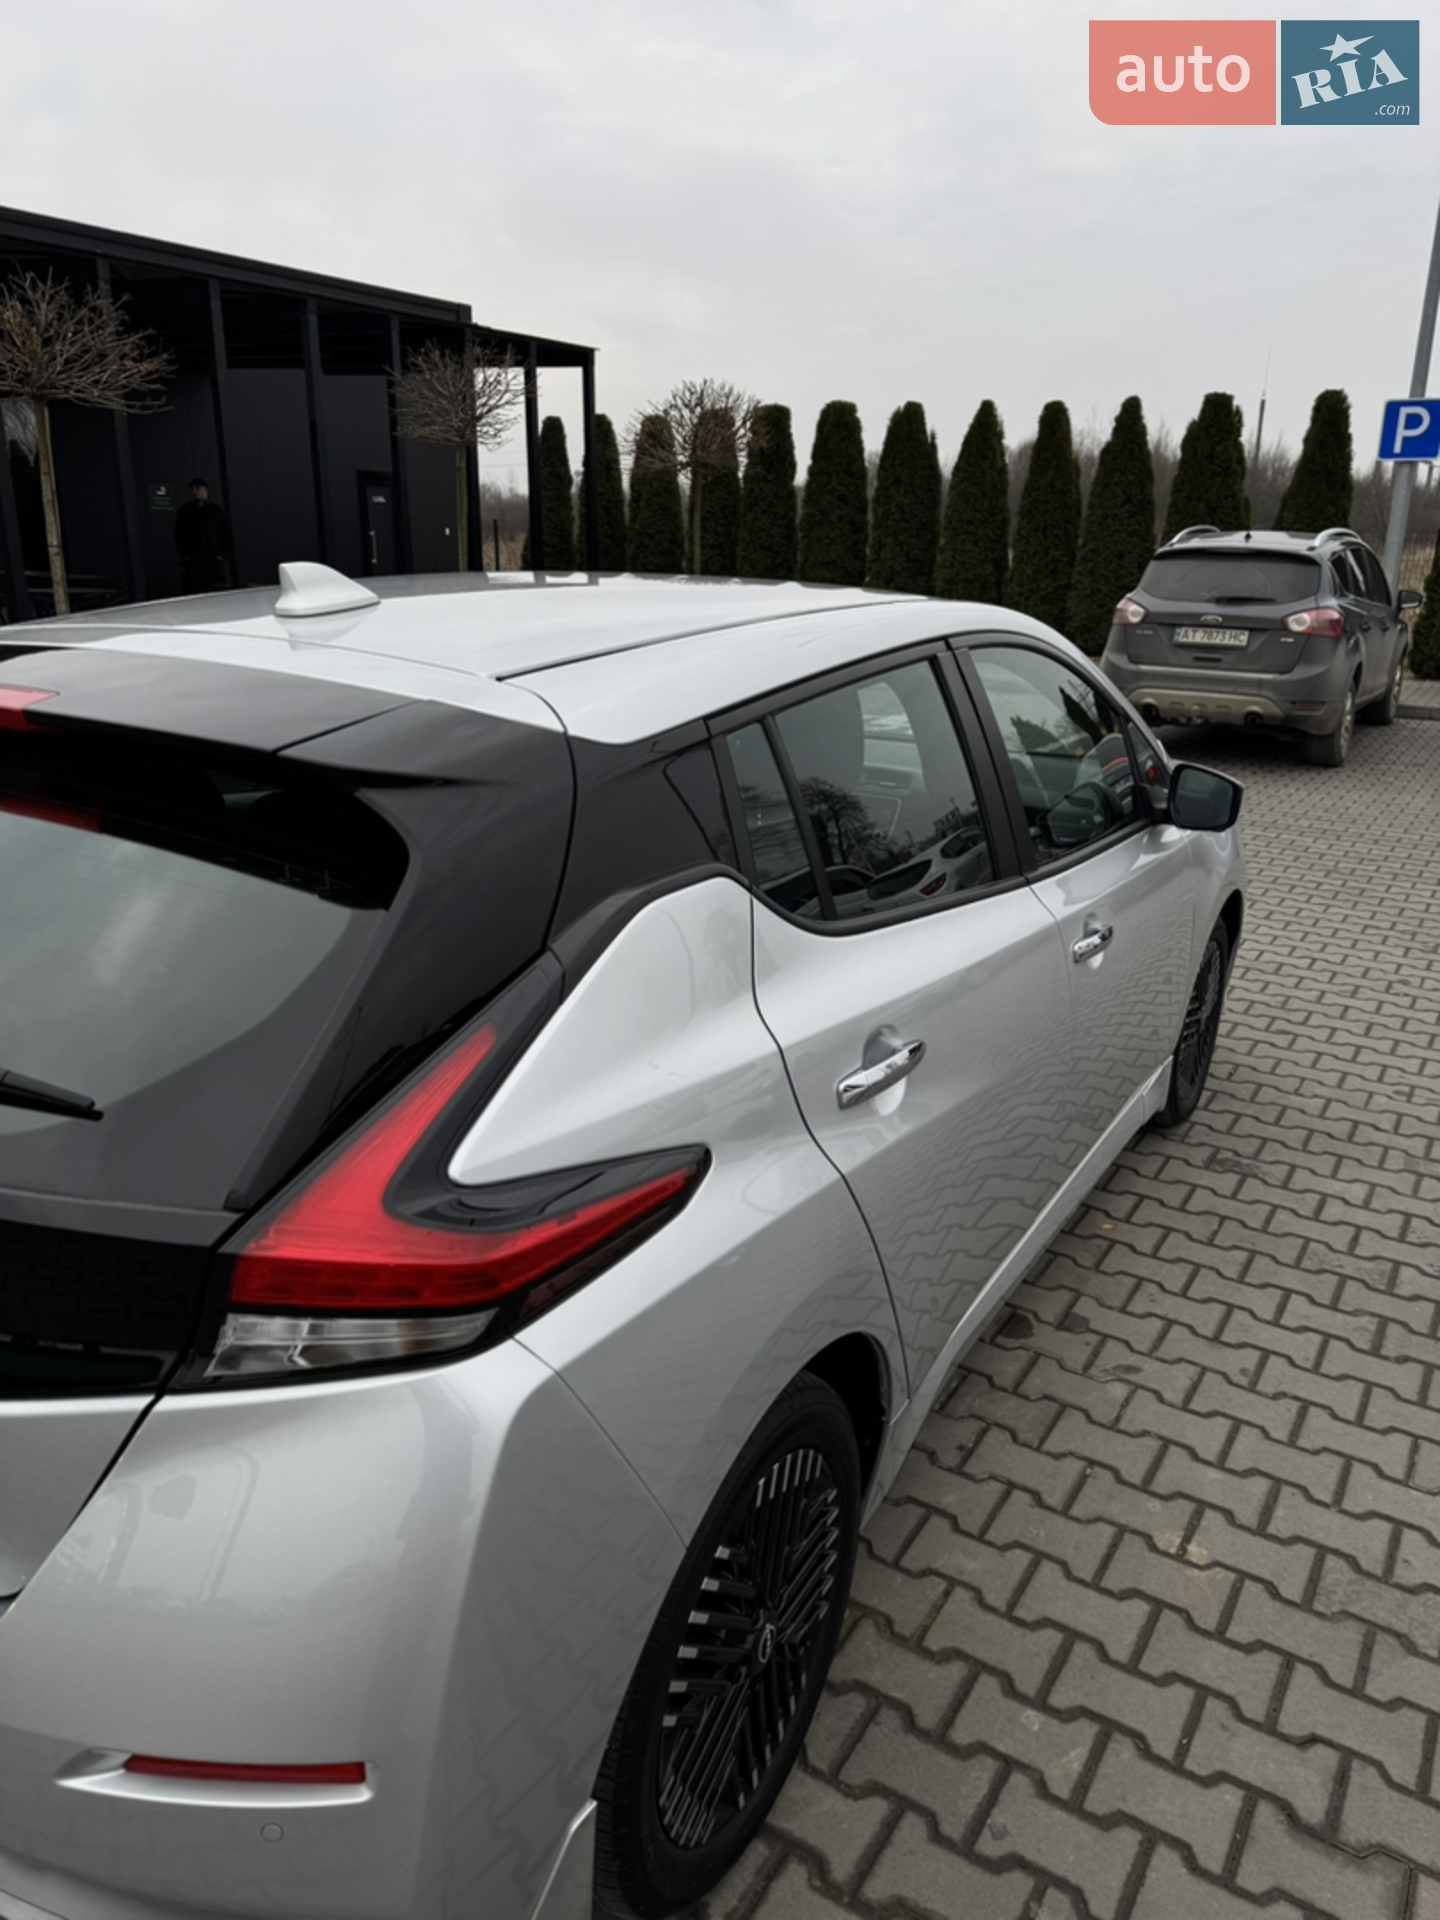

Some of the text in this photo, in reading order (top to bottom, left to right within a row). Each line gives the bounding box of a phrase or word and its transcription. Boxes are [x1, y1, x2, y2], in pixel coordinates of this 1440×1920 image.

[1393, 406, 1430, 454] P
[1182, 628, 1246, 644] AT 7873 HC
